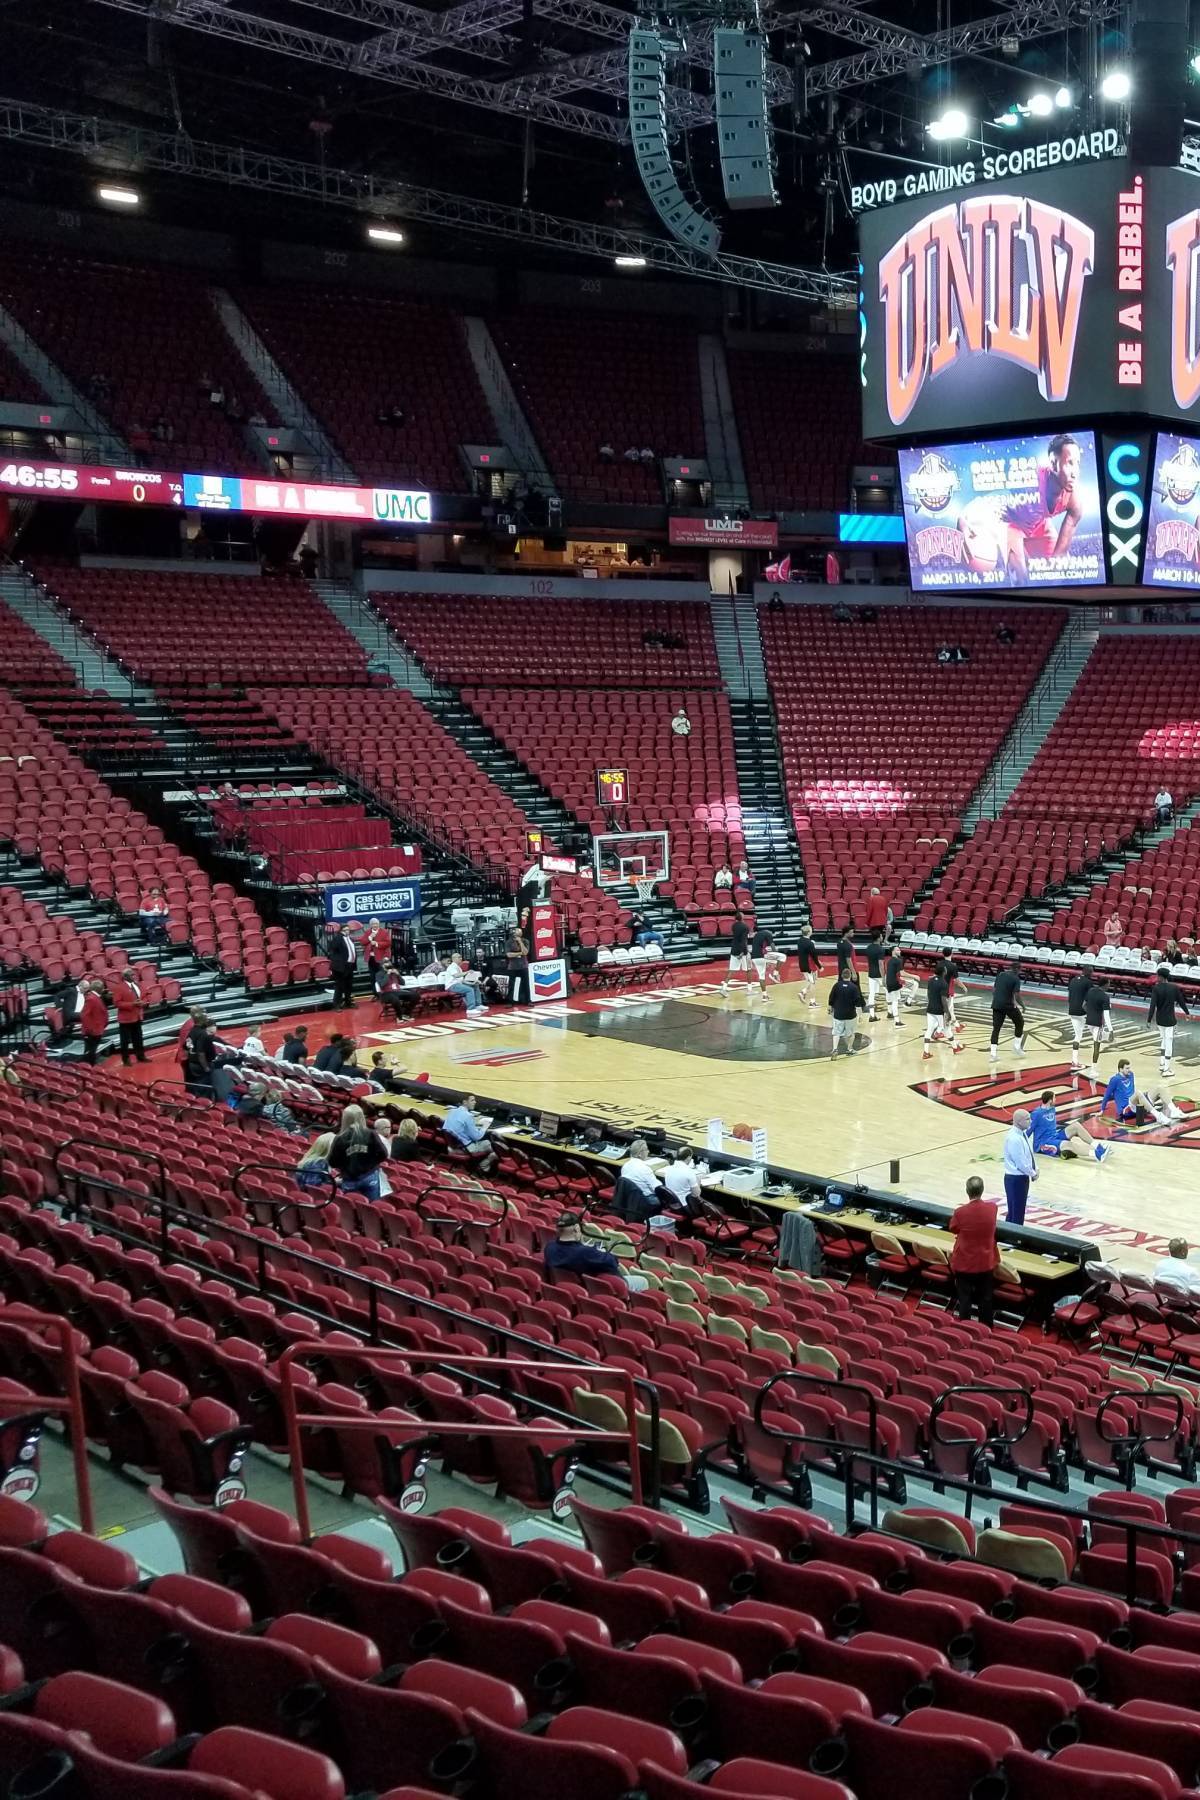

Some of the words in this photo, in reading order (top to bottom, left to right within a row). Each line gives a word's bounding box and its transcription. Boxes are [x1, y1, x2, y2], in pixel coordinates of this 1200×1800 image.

[851, 179, 897, 208] BOYD
[903, 163, 976, 197] GAMING
[983, 128, 1119, 180] SCOREBOARD
[1118, 175, 1143, 292] REBEL.
[879, 195, 1095, 426] UNLV
[1118, 304, 1143, 331] A
[1118, 342, 1143, 386] BE
[0, 465, 78, 490] 46:55
[133, 484, 145, 502] 0
[1107, 444, 1143, 567] COX
[376, 493, 429, 520] UMC
[916, 526, 965, 564] UNLV
[529, 581, 553, 594] 102
[922, 574, 954, 584] MARCH
[955, 573, 981, 585] 10-16,
[984, 572, 1004, 583] 2019
[600, 772, 624, 784] 46:55
[613, 783, 622, 801] 0
[356, 894, 374, 904] CBS
[375, 892, 410, 902] SPORTS
[356, 900, 402, 912] NETWORK
[533, 962, 561, 972] Chevron
